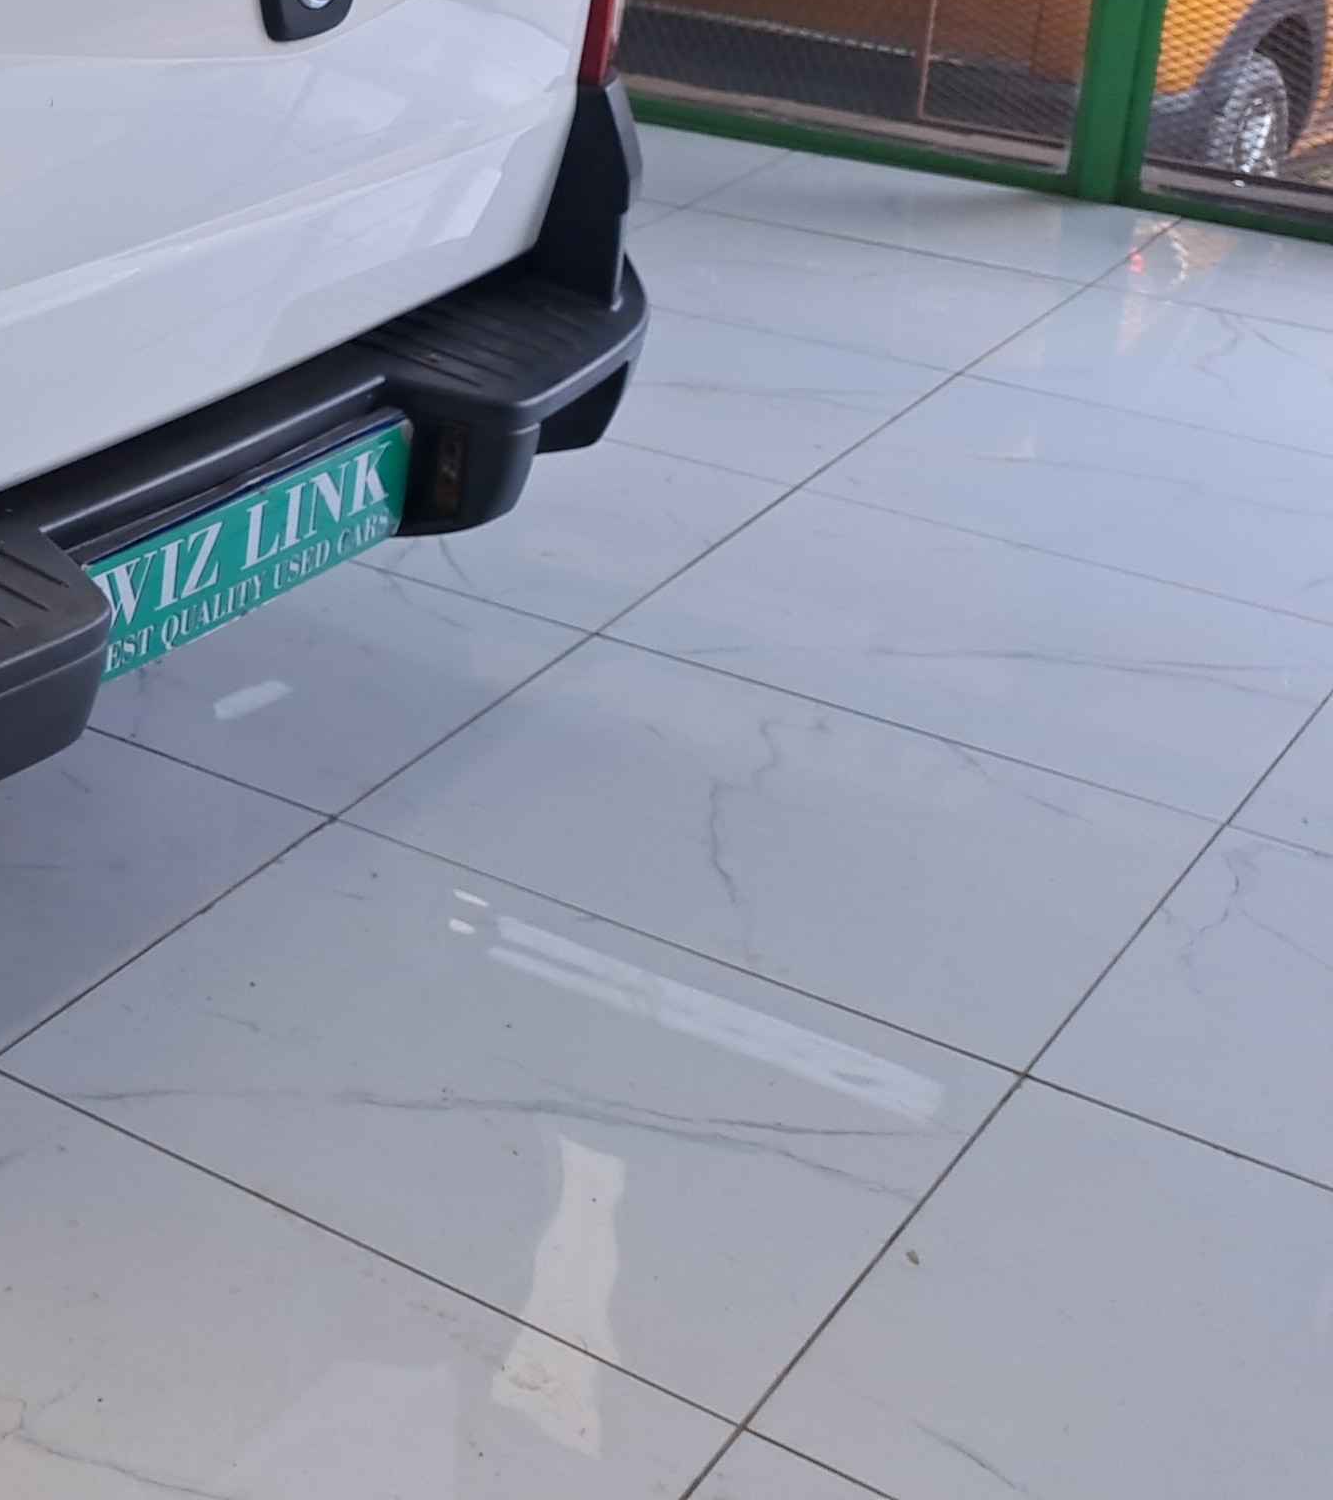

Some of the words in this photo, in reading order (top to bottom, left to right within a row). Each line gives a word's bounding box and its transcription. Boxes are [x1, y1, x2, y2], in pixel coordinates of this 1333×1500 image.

[91, 521, 223, 629] WIZ
[240, 440, 393, 571] LINK
[105, 625, 155, 673] EST
[160, 579, 264, 651] QUALITY
[273, 542, 330, 591] USED
[336, 510, 390, 556] CARS
